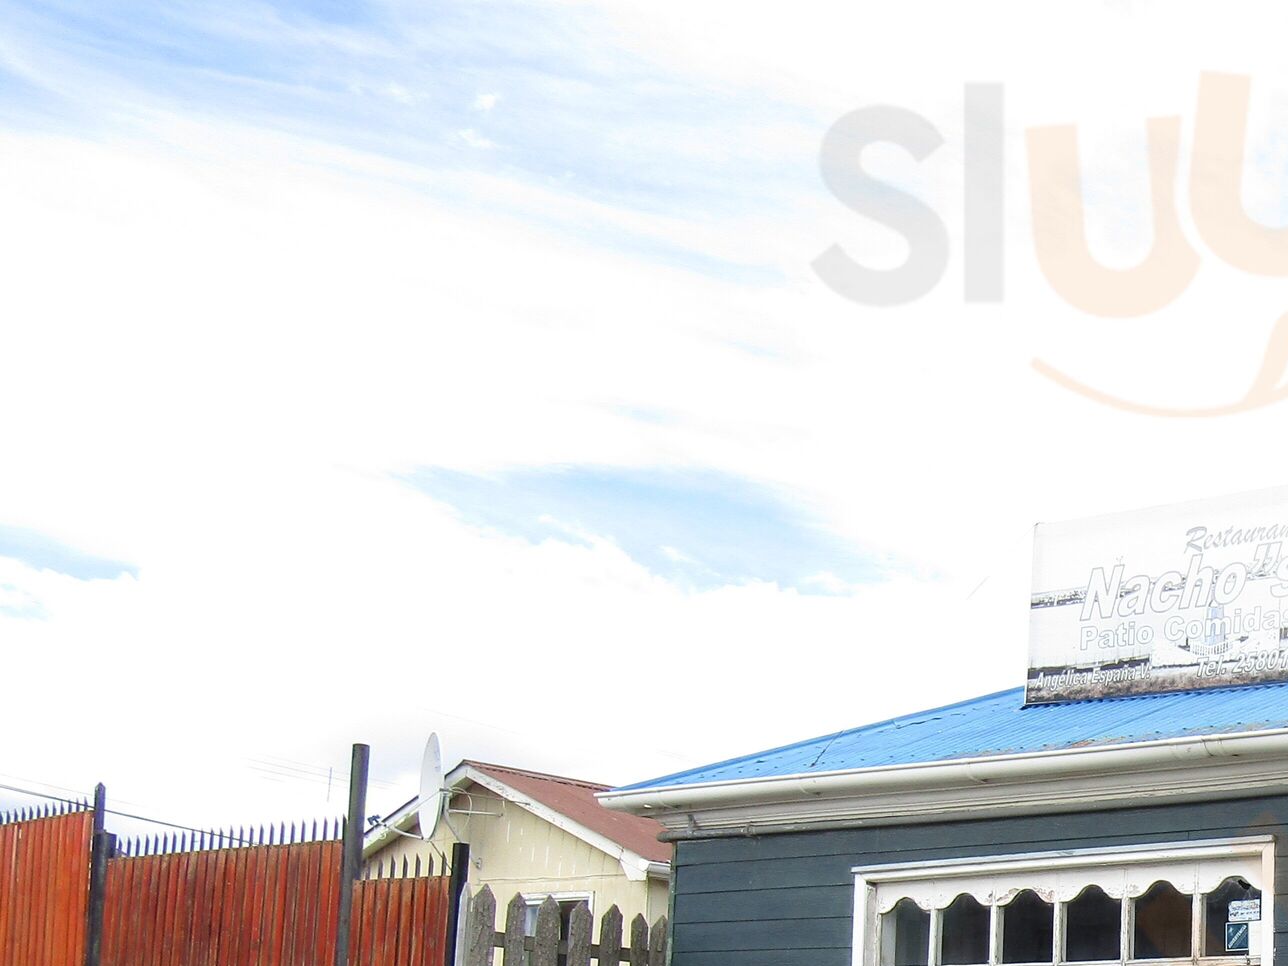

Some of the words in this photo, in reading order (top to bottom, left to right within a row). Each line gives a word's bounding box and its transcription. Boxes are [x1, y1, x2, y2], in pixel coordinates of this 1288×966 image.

[1080, 620, 1153, 650] Patio
[1034, 668, 1089, 692] Angélica
[1091, 663, 1139, 687] España
[1197, 657, 1226, 677] Tel.
